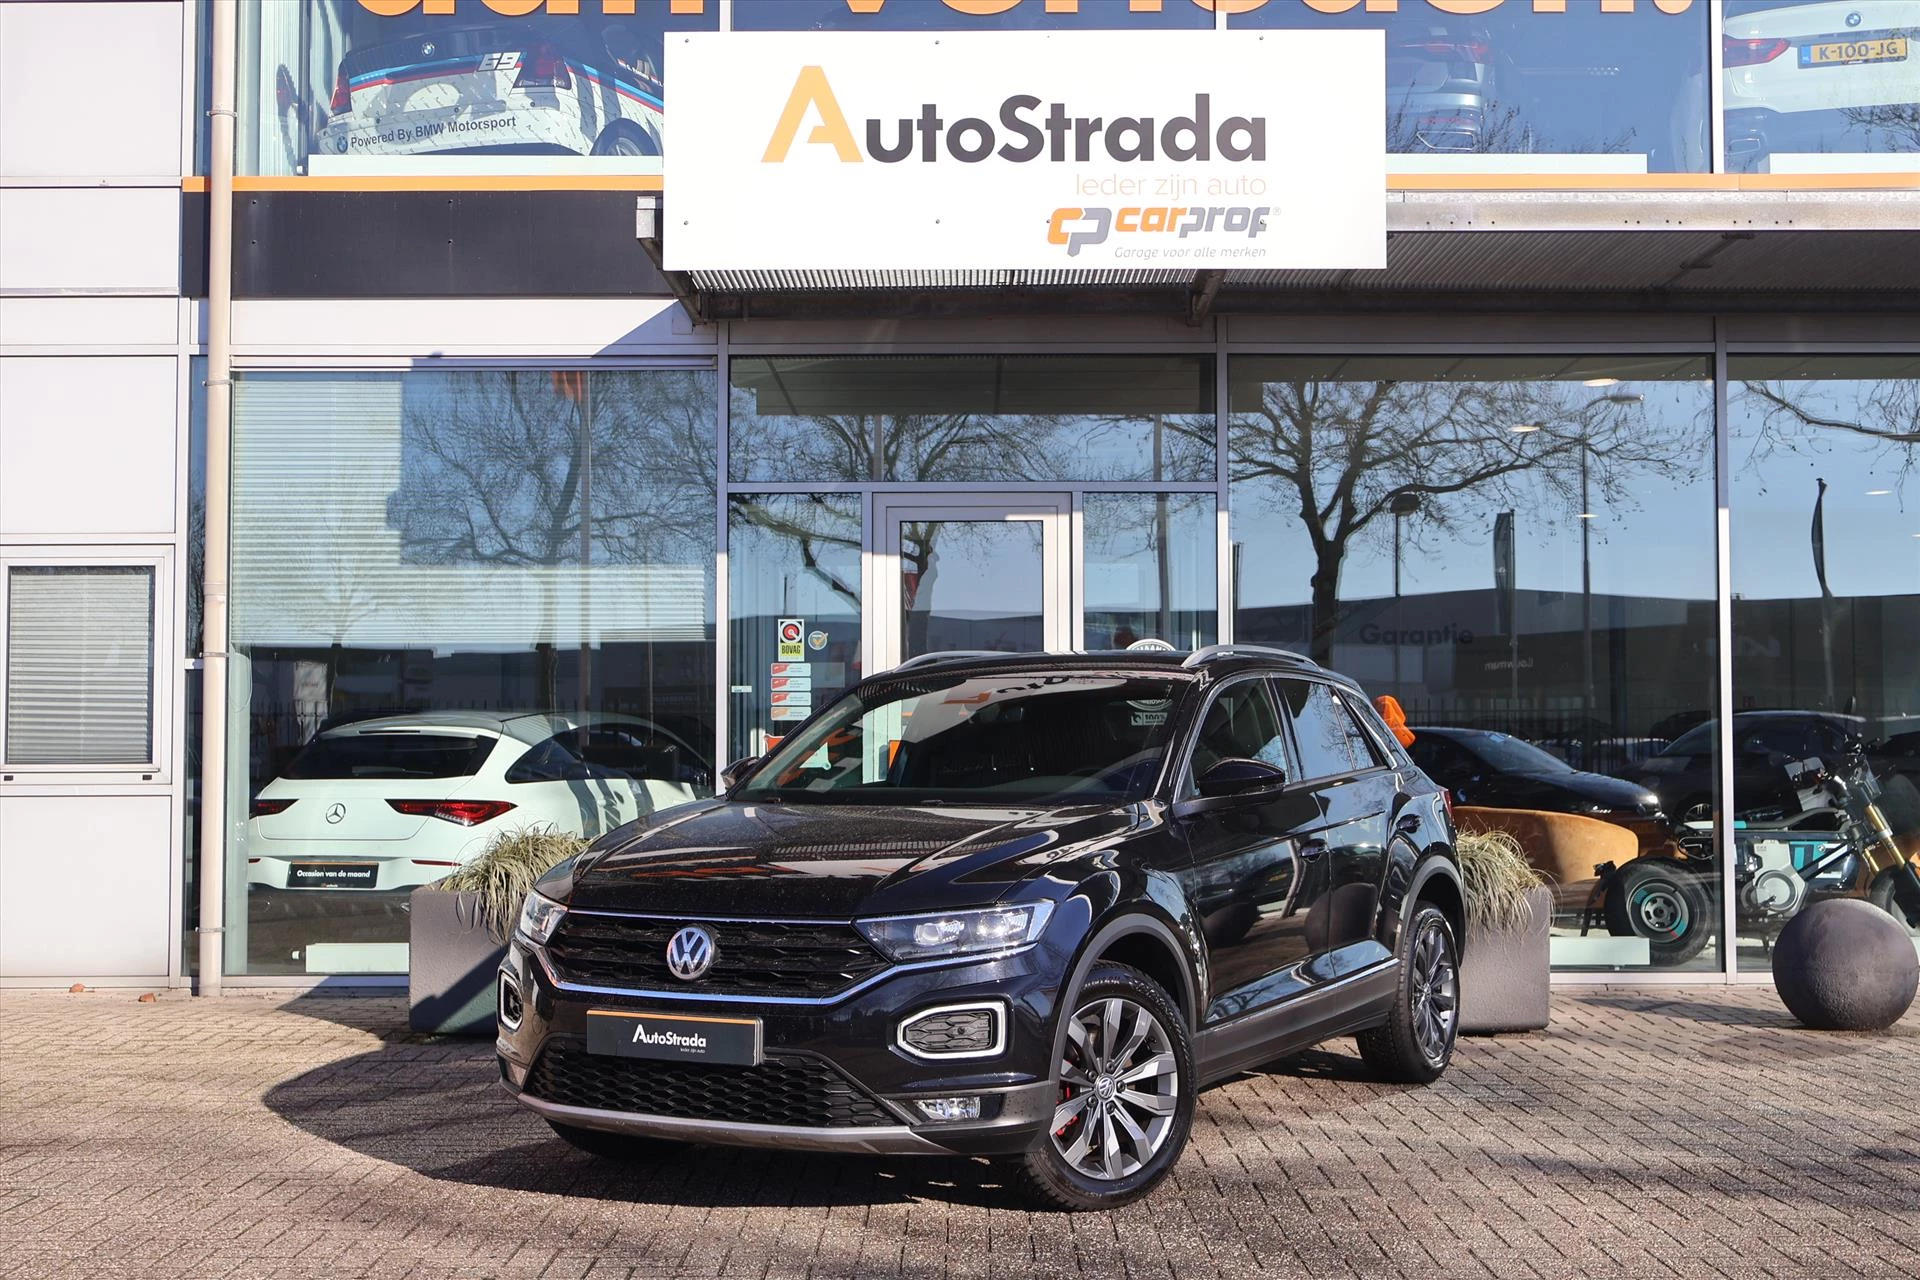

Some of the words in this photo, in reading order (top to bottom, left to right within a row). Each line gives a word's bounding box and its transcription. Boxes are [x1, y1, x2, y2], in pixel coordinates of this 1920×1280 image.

[478, 51, 521, 71] 69
[1819, 41, 1898, 60] K-100-JG
[761, 66, 1266, 164] AutoStrada
[350, 130, 394, 148] Powered
[398, 128, 412, 141] By
[416, 123, 444, 138] BMW
[447, 115, 516, 133] Motorsport
[1076, 174, 1146, 196] Ieder
[1155, 174, 1198, 201] zijn
[1207, 175, 1266, 196] auto
[1114, 246, 1158, 261] Garage
[1163, 248, 1191, 258] voor
[1194, 247, 1218, 258] alle
[1220, 247, 1266, 258] merken
[1360, 622, 1474, 645] Garantie
[781, 644, 801, 655] BOVAG
[297, 869, 324, 877] Occasion
[338, 869, 347, 878] de
[347, 869, 371, 878] maand
[632, 1024, 706, 1047] AutoStrada
